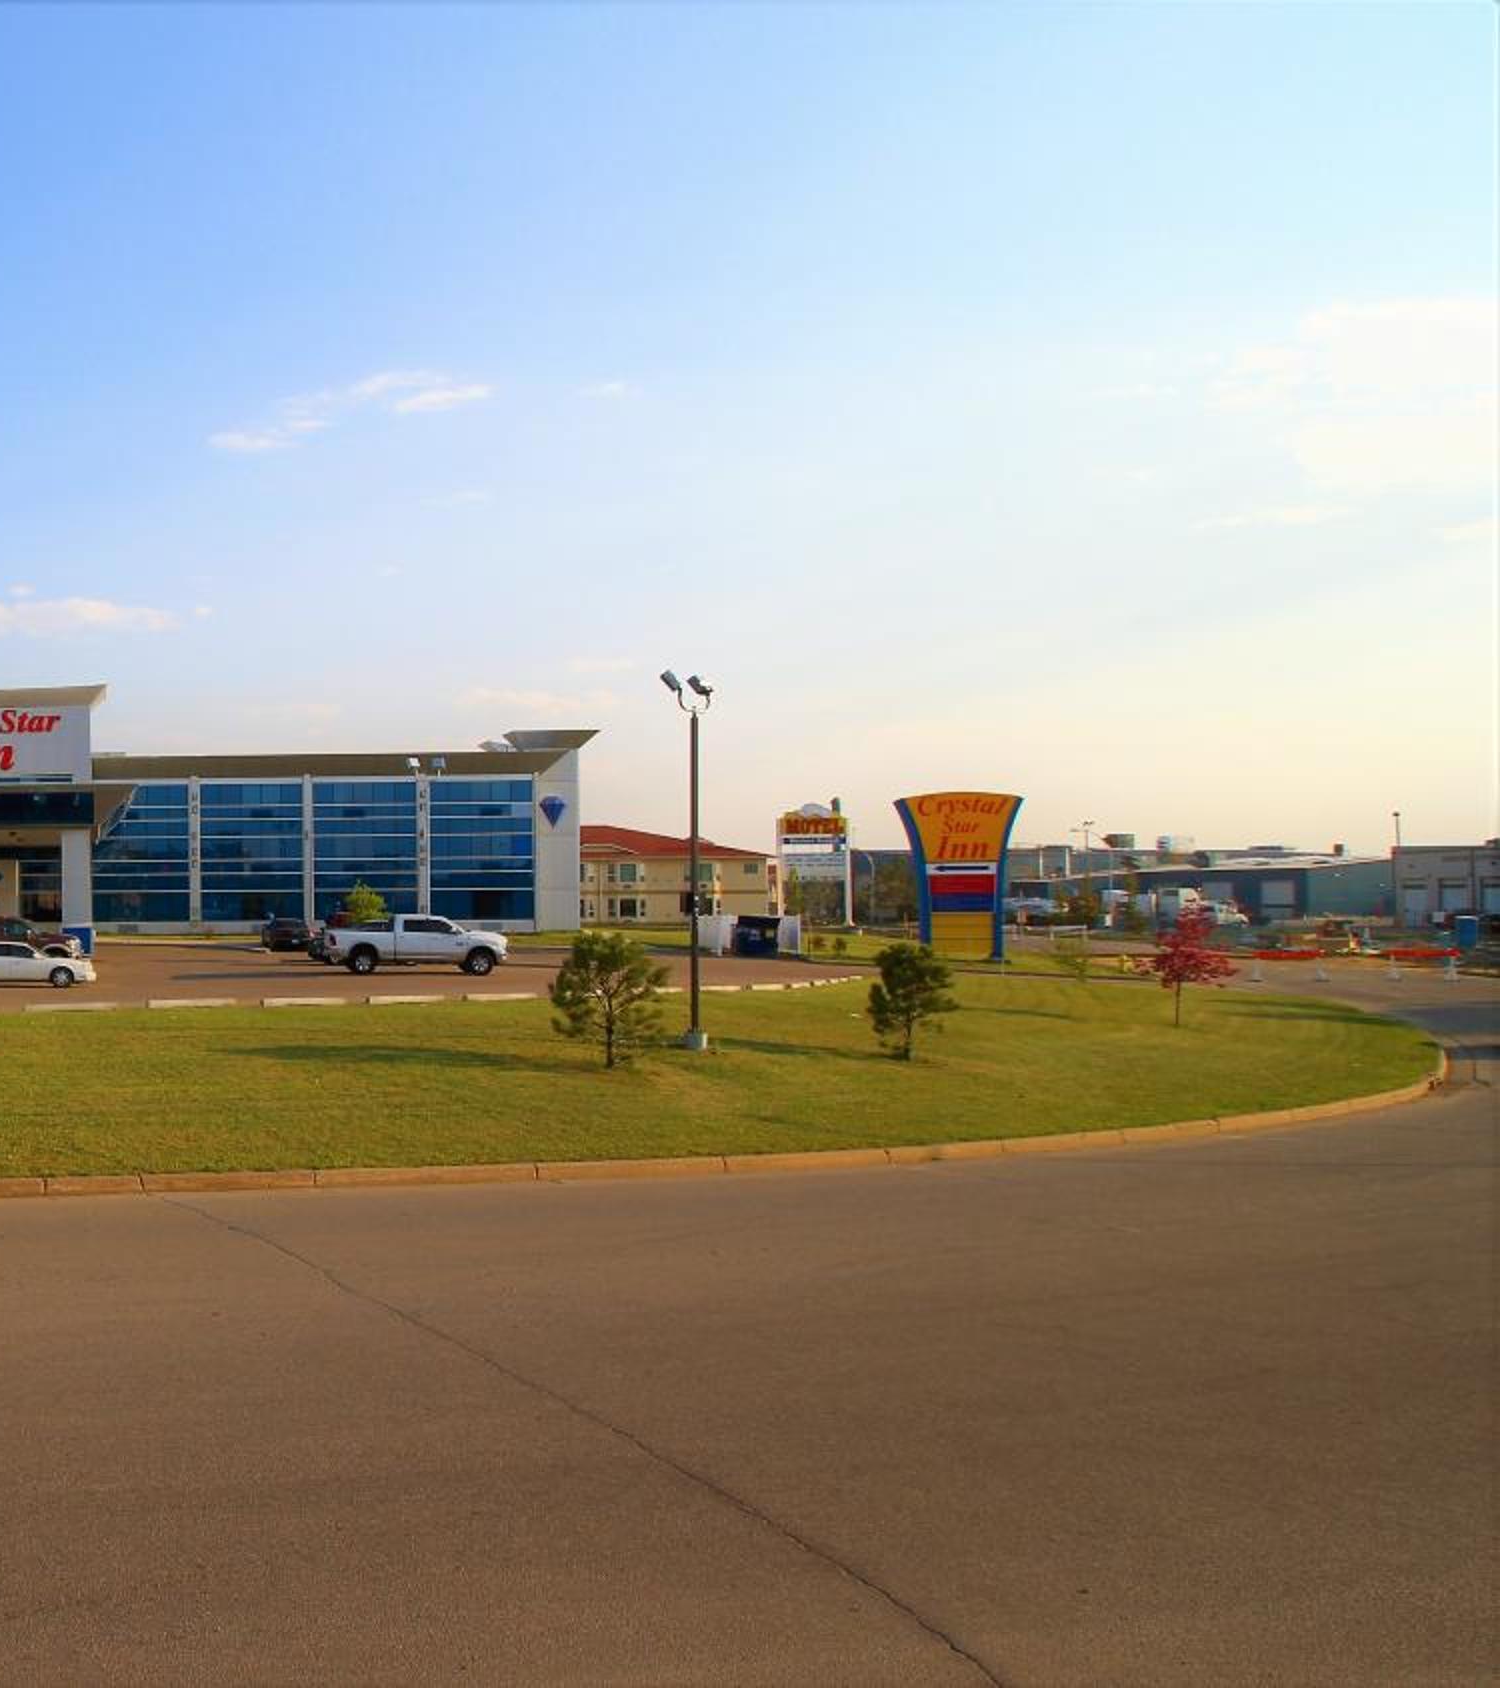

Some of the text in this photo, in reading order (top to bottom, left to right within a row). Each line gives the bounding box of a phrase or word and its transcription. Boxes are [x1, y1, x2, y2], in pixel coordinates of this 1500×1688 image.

[917, 797, 1008, 816] Crystal
[786, 818, 845, 834] MOTEL
[943, 817, 980, 833] Star
[935, 836, 989, 859] Inn
